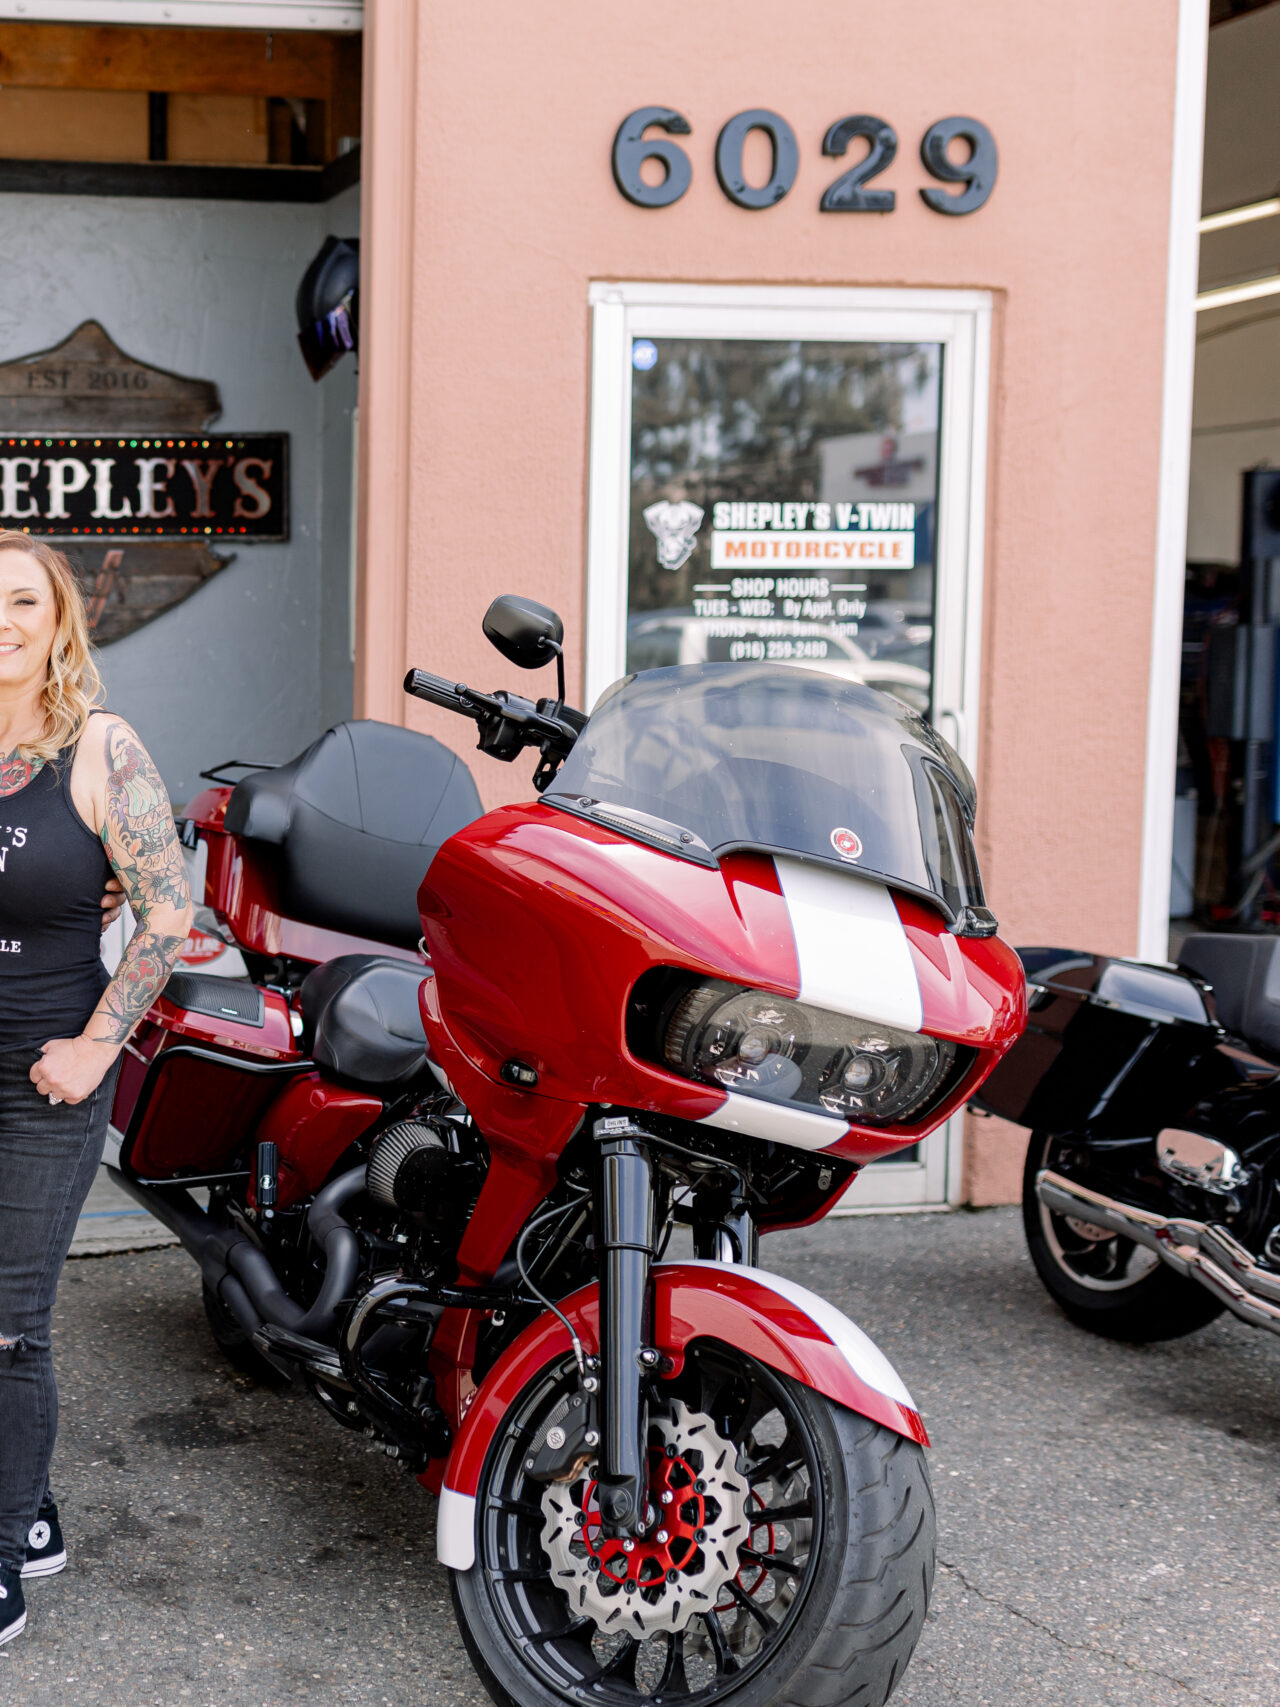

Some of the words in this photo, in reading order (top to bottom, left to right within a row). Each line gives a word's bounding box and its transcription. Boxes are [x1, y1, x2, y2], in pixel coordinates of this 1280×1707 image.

[611, 106, 998, 217] 6029
[88, 369, 149, 391] 2016
[713, 501, 831, 531] SHEPLEY'S
[835, 502, 915, 531] V-TWIN
[724, 541, 905, 559] MOTORCYCLE
[731, 577, 774, 598] SHOP
[776, 577, 829, 598] HOURS
[693, 599, 729, 617] TUES
